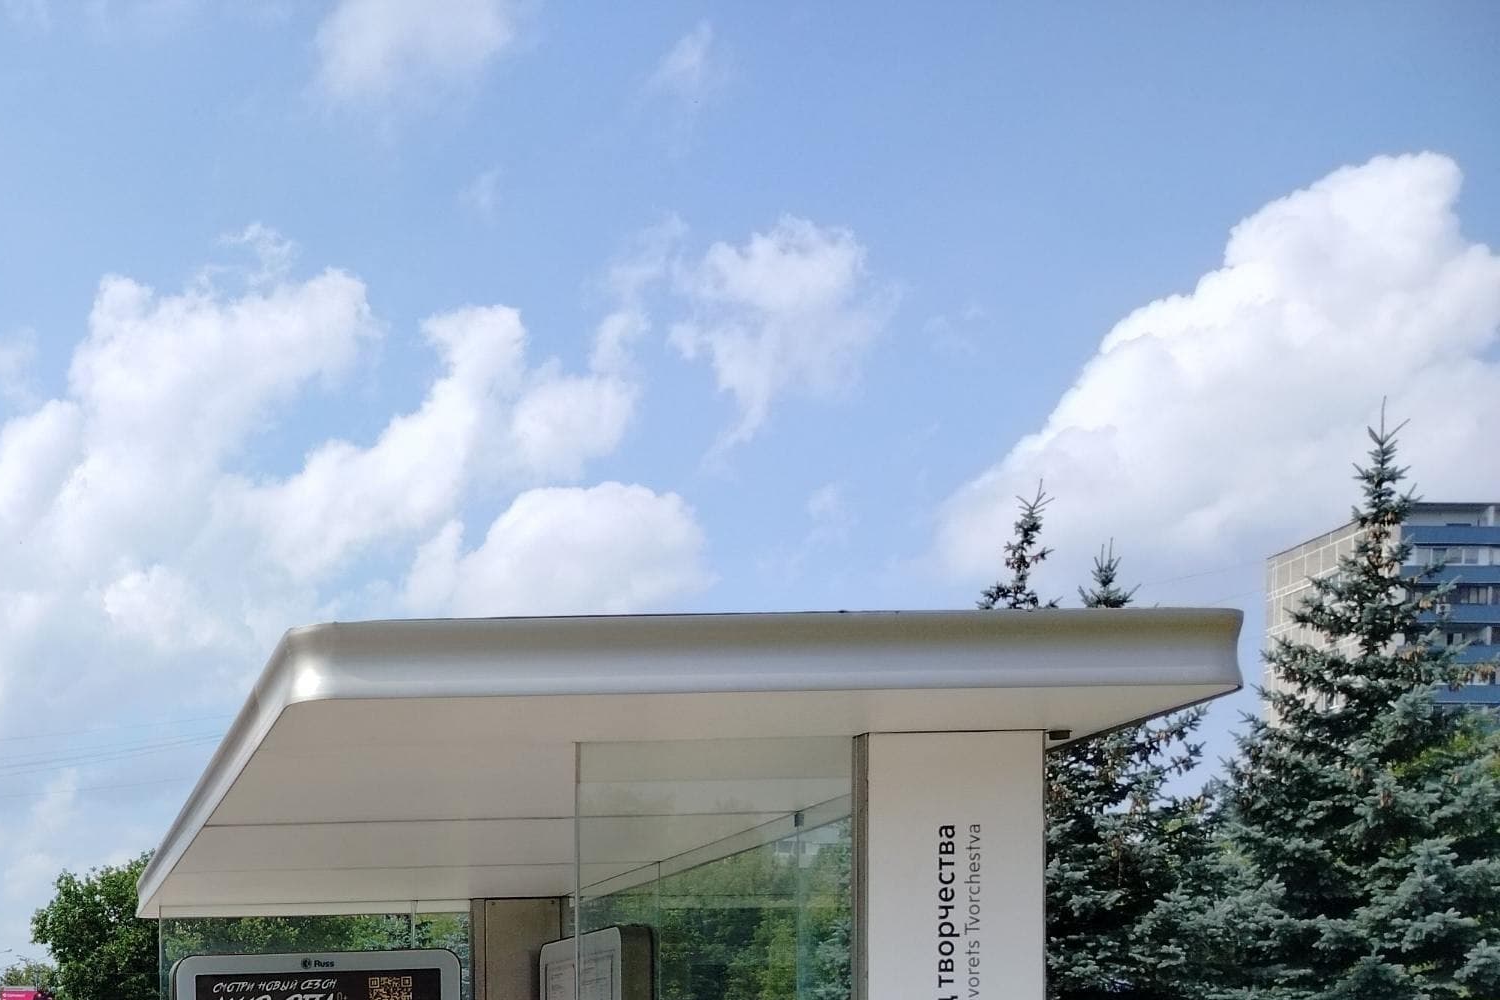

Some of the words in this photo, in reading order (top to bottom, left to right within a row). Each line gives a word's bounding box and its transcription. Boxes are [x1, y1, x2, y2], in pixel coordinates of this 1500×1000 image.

[938, 824, 960, 988] творчества
[964, 823, 981, 935] Tvorchestva
[213, 982, 255, 993] СМОТРИ
[258, 980, 298, 992] НОВЫЙ
[300, 979, 338, 990] СЕЗОН
